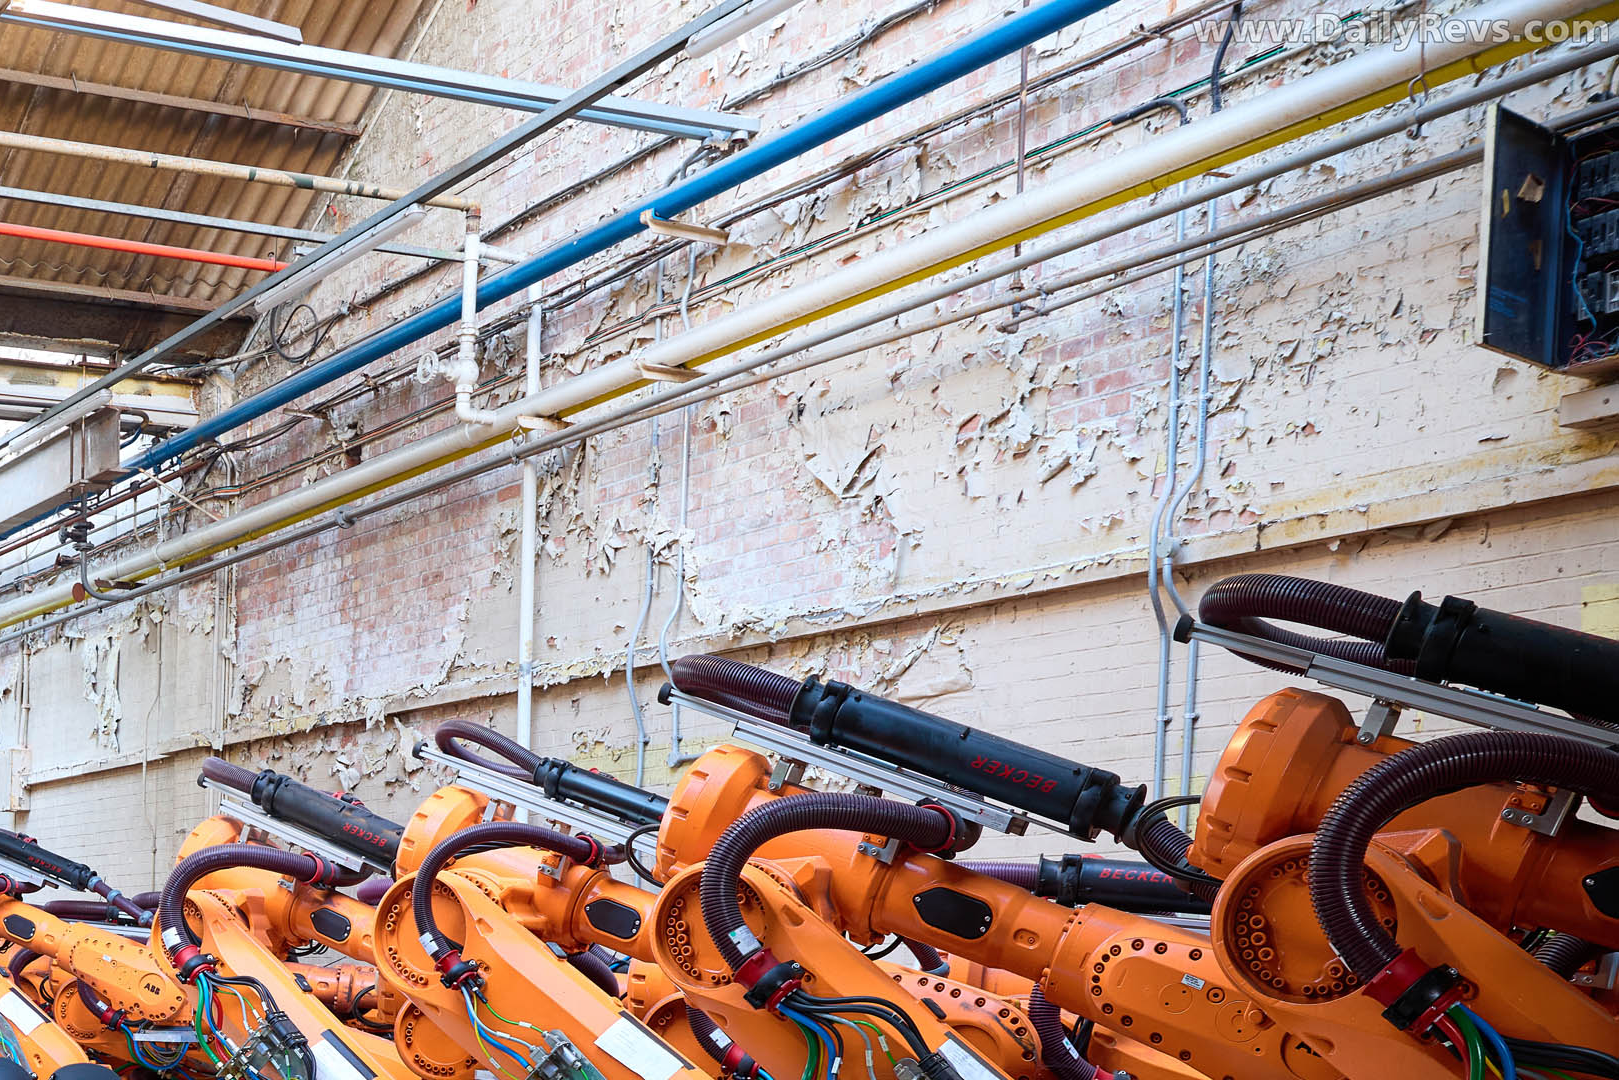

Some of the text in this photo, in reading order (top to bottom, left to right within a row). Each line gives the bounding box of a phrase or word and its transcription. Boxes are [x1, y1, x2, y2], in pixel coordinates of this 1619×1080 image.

[971, 755, 1058, 793] BECKER
[342, 822, 388, 847] BECKER
[1100, 867, 1173, 884] BECKER
[144, 983, 160, 995] ABB
